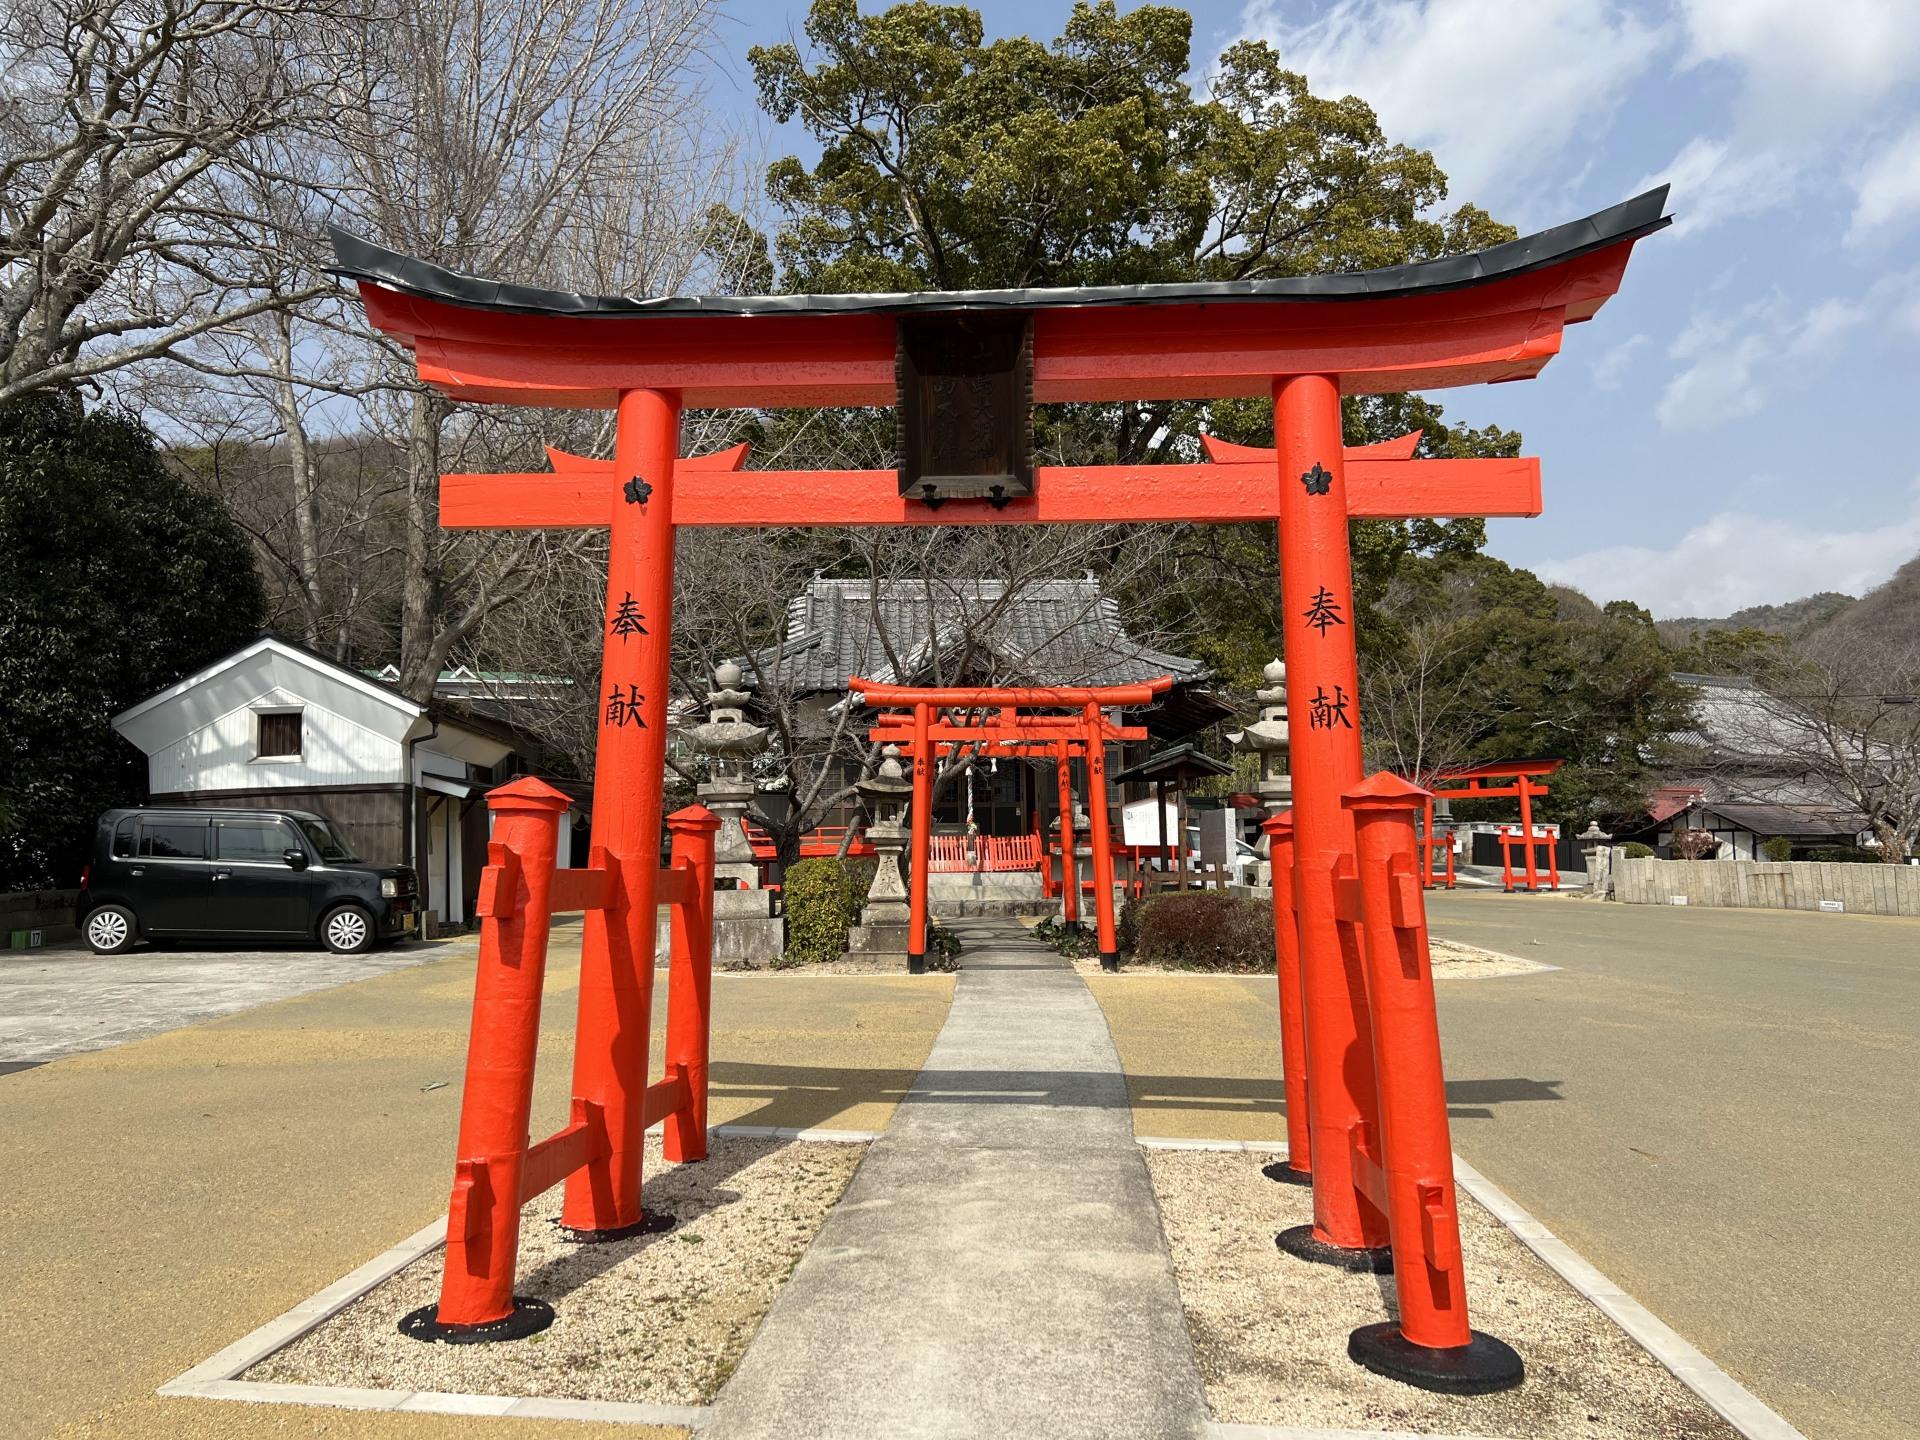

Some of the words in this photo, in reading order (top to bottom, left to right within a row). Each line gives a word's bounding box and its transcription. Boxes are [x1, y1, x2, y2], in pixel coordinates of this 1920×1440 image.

[606, 591, 650, 729] 奉献
[1302, 586, 1353, 730] 奉献
[1094, 756, 1104, 775] 奉献
